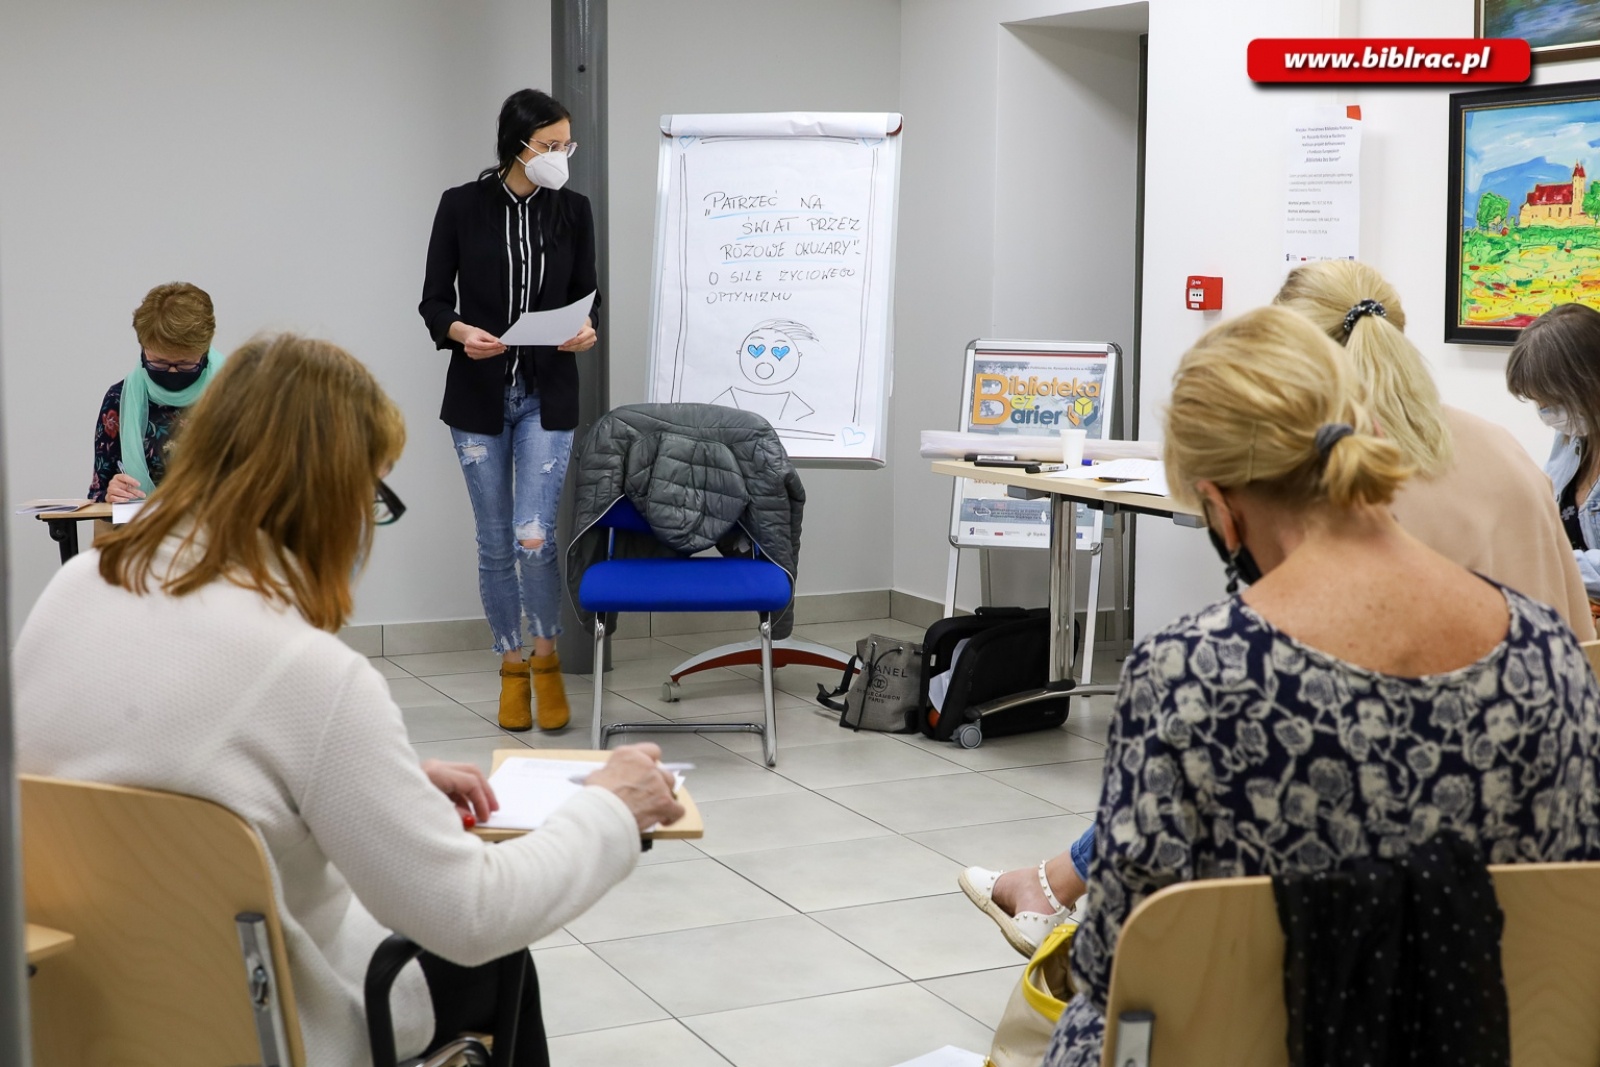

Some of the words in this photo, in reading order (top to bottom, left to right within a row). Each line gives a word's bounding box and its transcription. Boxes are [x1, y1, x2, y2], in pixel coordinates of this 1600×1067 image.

[800, 194, 825, 210] NA
[742, 216, 799, 234] ŚWIAT
[807, 217, 861, 231] PRZEZ
[708, 271, 719, 285] O
[730, 270, 763, 283] SILE
[706, 291, 792, 304] OPTYMIZMU
